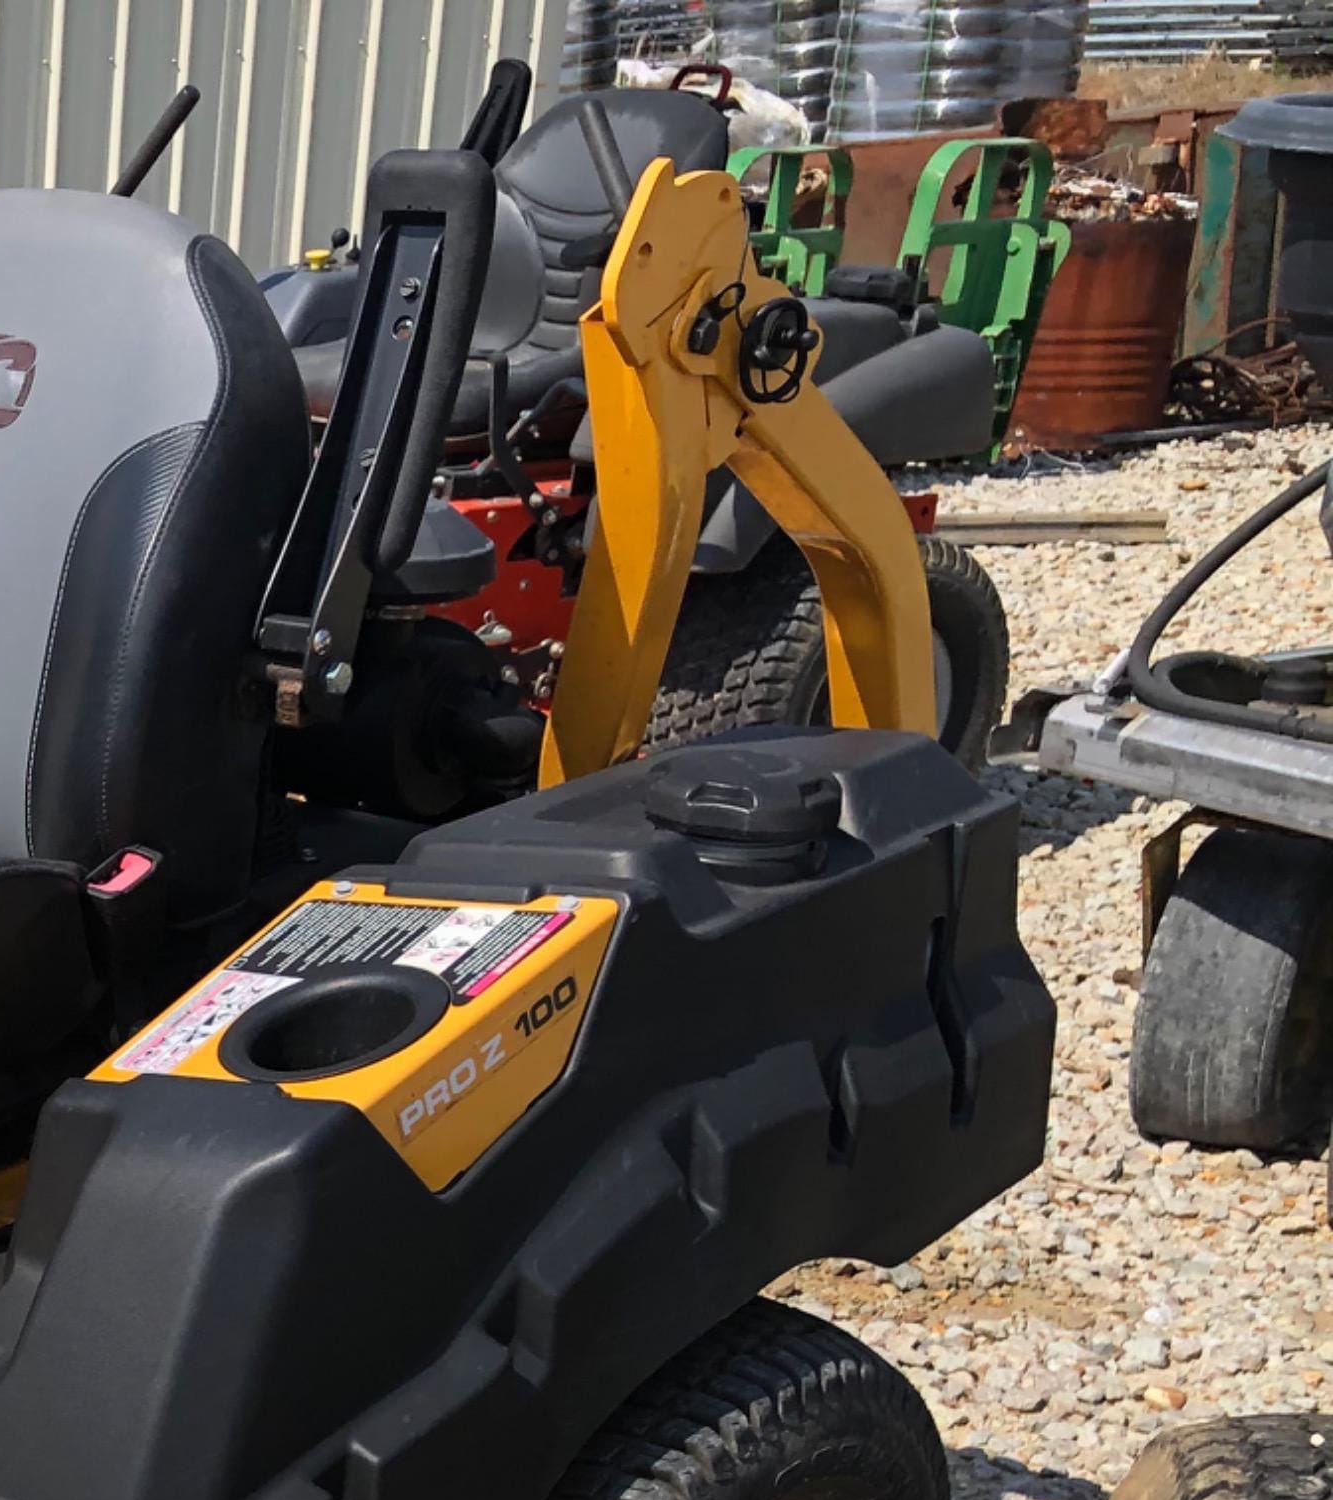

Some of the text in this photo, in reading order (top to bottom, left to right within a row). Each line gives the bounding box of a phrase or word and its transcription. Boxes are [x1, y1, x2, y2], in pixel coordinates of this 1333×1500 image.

[399, 976, 577, 1136] PRO Z 100
